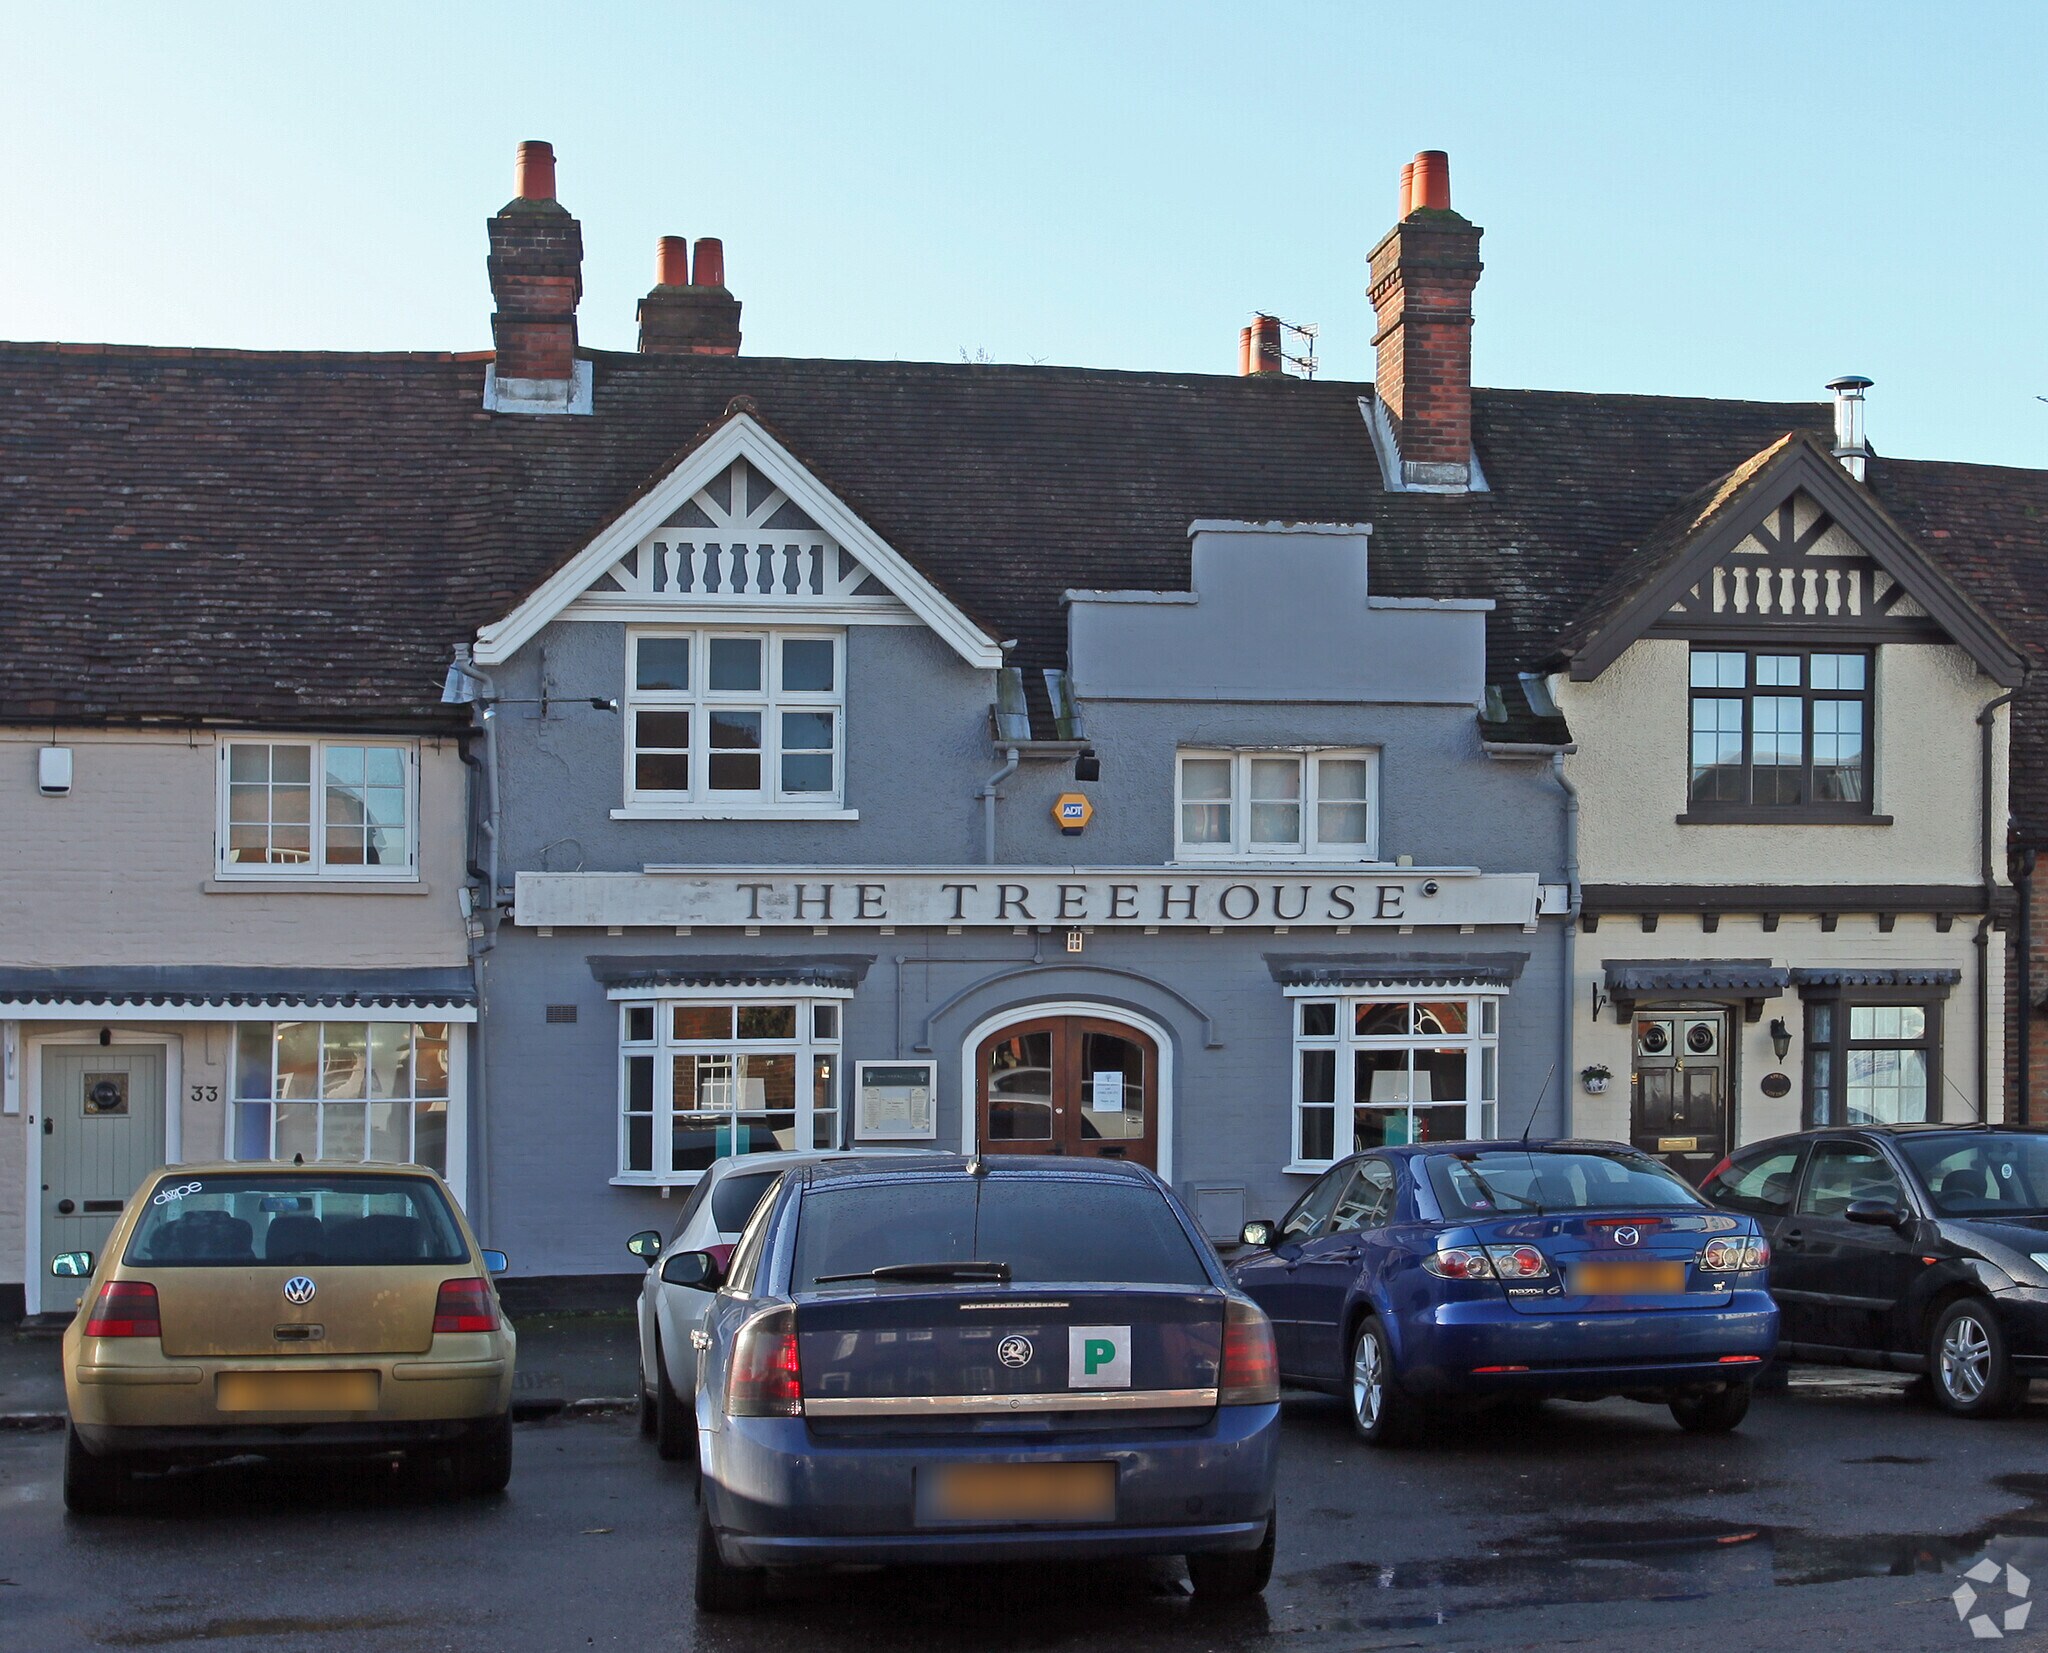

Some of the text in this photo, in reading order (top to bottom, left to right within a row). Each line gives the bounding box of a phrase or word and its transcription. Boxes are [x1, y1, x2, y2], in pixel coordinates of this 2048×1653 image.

[1063, 806, 1083, 816] ADT
[737, 883, 1406, 921] THE TREEHOUSE
[191, 1085, 218, 1102] 33
[1547, 1285, 1561, 1295] 6
[1084, 1339, 1116, 1375] P
